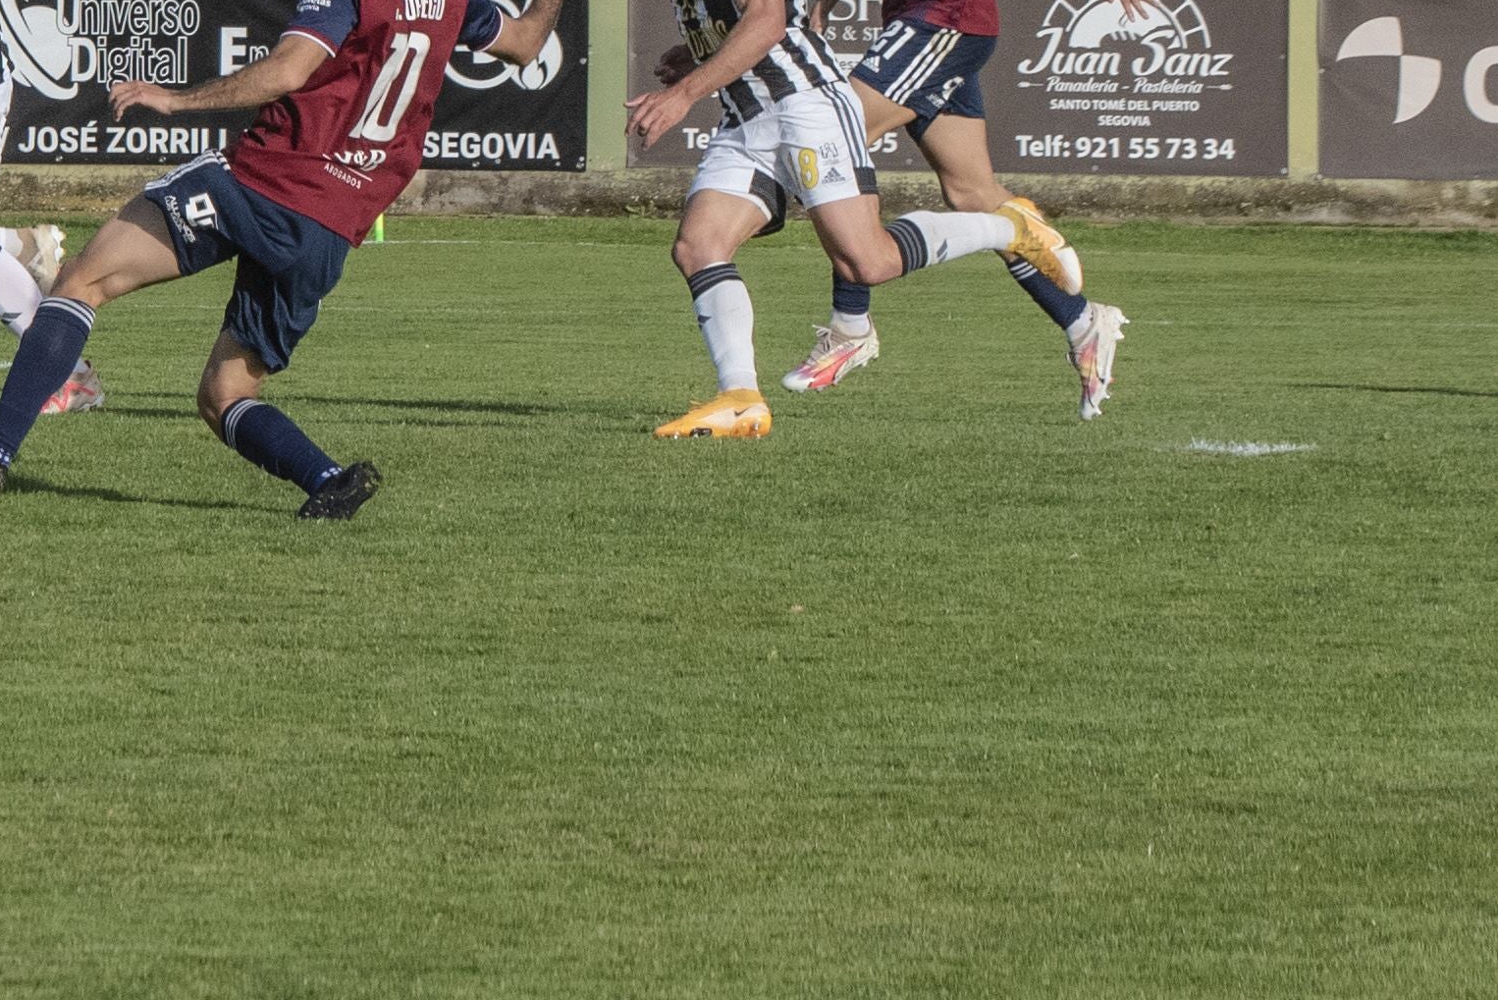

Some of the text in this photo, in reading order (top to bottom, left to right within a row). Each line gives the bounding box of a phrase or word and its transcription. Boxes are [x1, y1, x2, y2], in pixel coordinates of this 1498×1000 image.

[870, 19, 916, 60] 21
[1017, 27, 1234, 76] Juan Sanz
[68, 36, 188, 91] Digital
[347, 29, 431, 143] 10
[1045, 76, 1120, 93] Panadería
[1132, 76, 1204, 94] Pastelería
[1049, 97, 1200, 112] SANTO TOMÉ DEL PUERTO
[18, 120, 98, 154] JOSÉ
[423, 131, 560, 160] SEGOVIA
[1098, 115, 1151, 127] SEGOVIA
[1015, 134, 1236, 159] Telf: 921 55 73 34
[798, 147, 820, 190] 8
